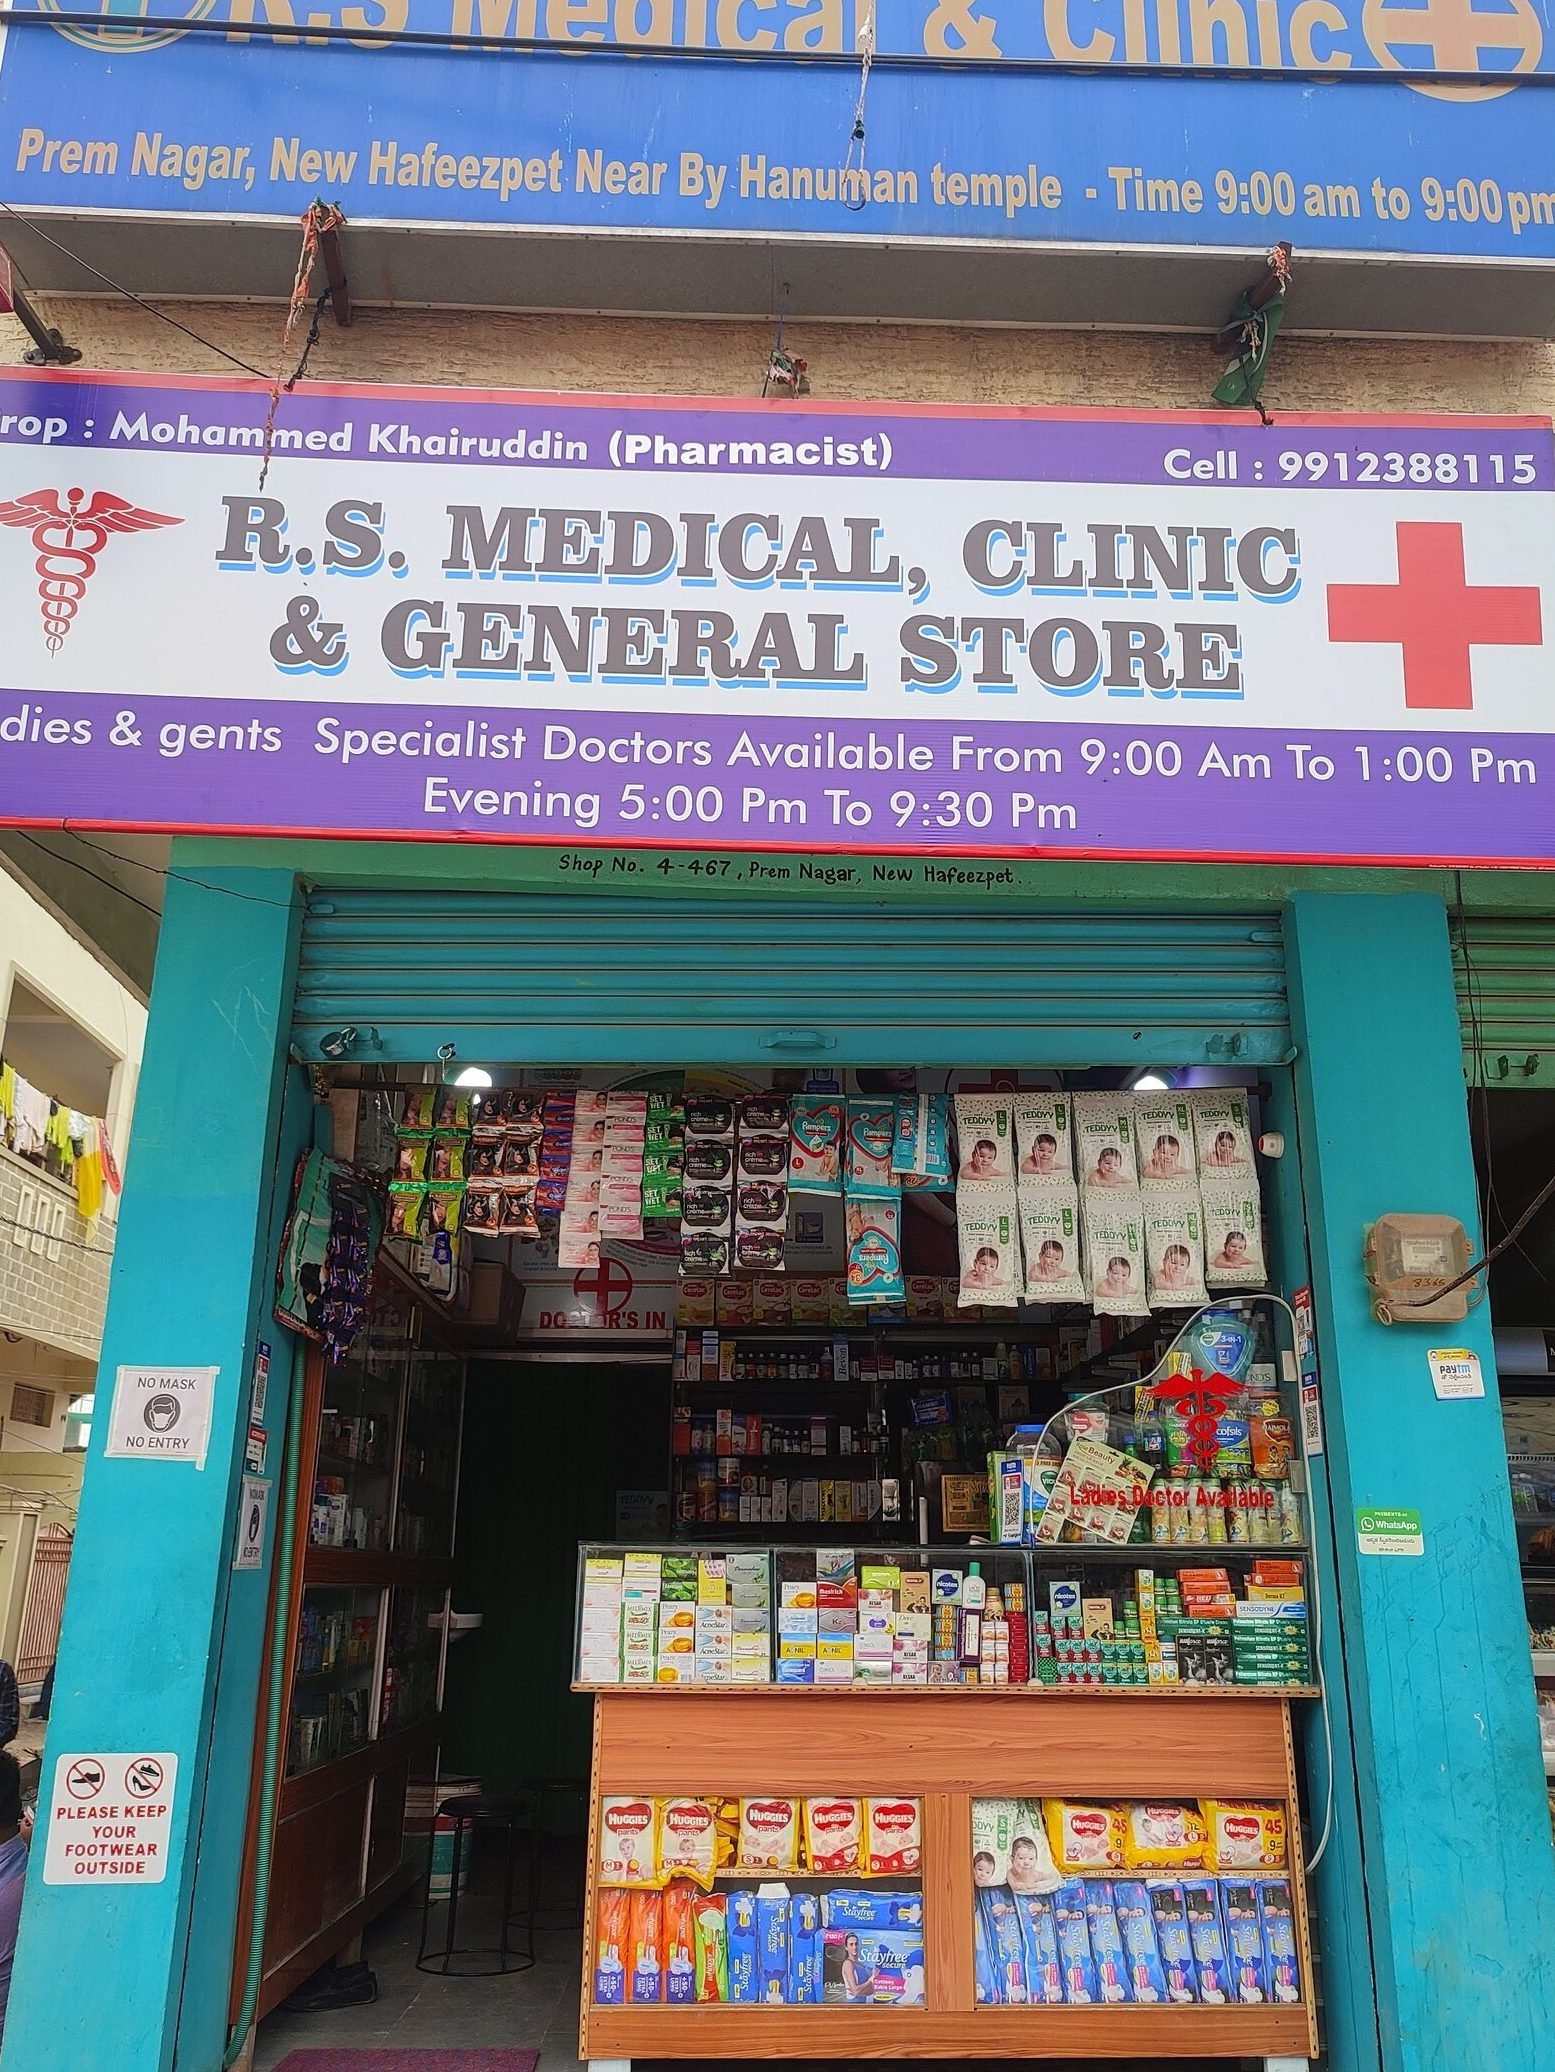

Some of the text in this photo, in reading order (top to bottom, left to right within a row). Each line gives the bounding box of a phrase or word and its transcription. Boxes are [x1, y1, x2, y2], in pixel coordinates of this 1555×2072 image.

[923, 0, 1002, 69] &
[1044, 0, 1352, 84] Clinic
[15, 128, 119, 175] Prem
[130, 131, 256, 192] Nagar,
[269, 136, 358, 184] New
[367, 140, 563, 201] Hafeezpet
[575, 148, 669, 195] Near
[678, 151, 728, 209] By
[738, 153, 918, 204] Hanuman
[930, 161, 1063, 218] temple
[1107, 165, 1203, 213] Time
[1214, 168, 1296, 217] 9:00
[1303, 182, 1361, 218] am
[1371, 176, 1411, 220] to
[1420, 176, 1503, 224] 9:00
[1506, 190, 1555, 235] pm
[109, 410, 353, 453] Mohammed
[367, 423, 588, 461] Khairuddin
[607, 430, 894, 471] (Pharmacist)
[1162, 448, 1239, 481] Cell
[1278, 449, 1537, 485] 9912388115
[215, 495, 1300, 603] R.S. MEDICAL, CLINIC
[270, 595, 1244, 700] & GENERAL STORE
[109, 709, 143, 747] &
[159, 718, 283, 758] gents
[314, 716, 525, 764] Specialist
[542, 724, 713, 768] Doctors
[726, 731, 934, 774] Available
[951, 735, 1063, 774] From
[1080, 739, 1183, 780] 9:00
[1197, 742, 1272, 780] Am
[1285, 743, 1336, 782] To
[1353, 745, 1454, 784] 1:00
[1470, 746, 1538, 784] Pm
[423, 776, 1078, 831] Evening 5:00 Pm To 9:30 Pm
[559, 854, 603, 878] Shop
[612, 856, 645, 873] No.
[749, 860, 791, 879] Prem
[799, 862, 862, 885] Nagar,
[873, 864, 913, 882] New
[649, 1094, 663, 1102] SET
[650, 1101, 665, 1110] WET
[962, 1116, 995, 1125] TEDDYY
[1020, 1110, 1054, 1119] TEDDYY
[1141, 1111, 1175, 1120] TEDDYY
[1200, 1110, 1230, 1119] TEDDYY
[647, 1126, 661, 1134] SET
[802, 1121, 831, 1133] Pampers
[863, 1127, 892, 1138] Pampers
[1084, 1124, 1118, 1133] TEDDYY
[647, 1133, 663, 1141] WET
[644, 1189, 658, 1198] SET
[644, 1197, 660, 1205] WET
[964, 1222, 998, 1231] TEDDYY
[1027, 1216, 1061, 1225] TEDDYY
[1151, 1219, 1186, 1229] TEDDYY
[645, 1311, 666, 1329] IN
[137, 1376, 197, 1391] NO MASK
[125, 1436, 191, 1450] NO ENTRY
[1088, 1446, 1116, 1465] Beauty
[1069, 1485, 1276, 1509] Ladies Doctor Available
[1375, 1520, 1418, 1531] WhatsApp
[936, 1580, 958, 1588] nicotex
[1054, 1592, 1076, 1600] nicotex
[56, 1804, 168, 1820] PLEASE KEEP
[750, 1808, 789, 1823] HUGGIES
[814, 1811, 853, 1824] HUGGIES
[875, 1813, 914, 1824] HUGGIES
[608, 1813, 649, 1826] HUGGIES
[669, 1813, 709, 1826] HUGGIES
[1072, 1819, 1105, 1831] HUGGIES
[92, 1825, 137, 1839] YOUR
[678, 1829, 700, 1837] pants
[757, 1825, 780, 1833] pants
[1225, 1823, 1259, 1835] HUGGIES
[1264, 1819, 1282, 1834] 45
[64, 1842, 158, 1858] FOOTWEAR
[74, 1860, 146, 1875] OUTSIDE
[842, 1905, 876, 1918] Stayfree
[770, 1916, 780, 1956] Stayfree
[858, 1947, 908, 1966] Stayfree
[740, 1952, 751, 1991] Stayfree
[803, 1955, 812, 1994] Stayfree
